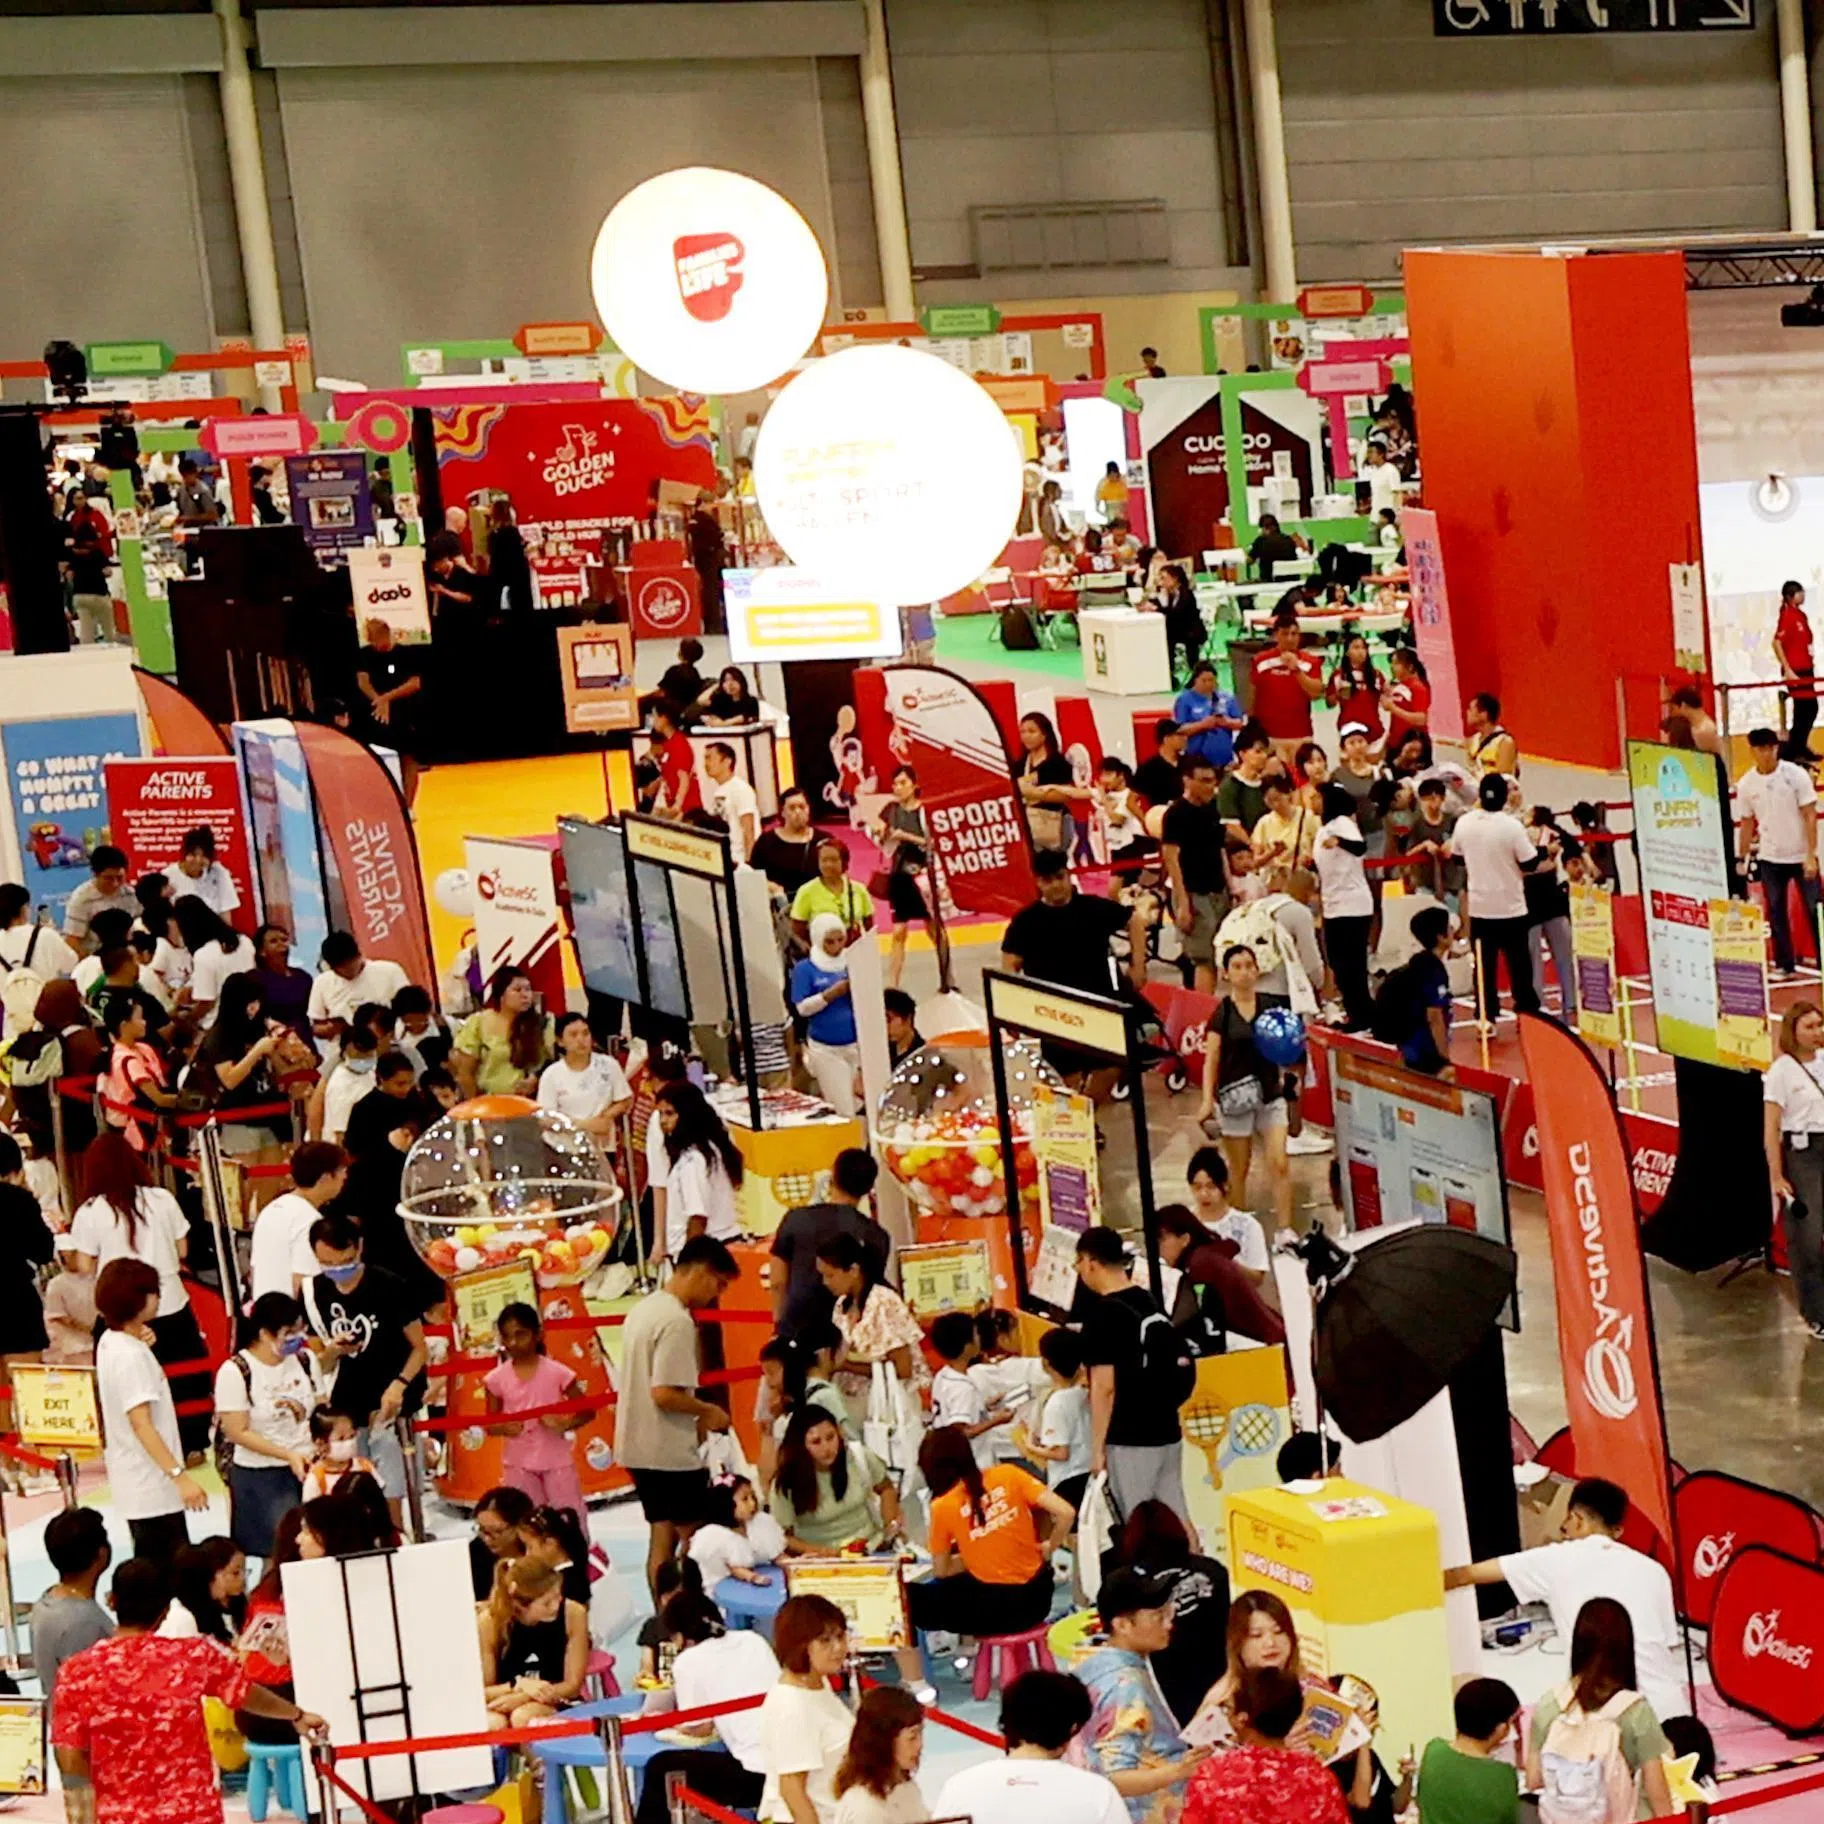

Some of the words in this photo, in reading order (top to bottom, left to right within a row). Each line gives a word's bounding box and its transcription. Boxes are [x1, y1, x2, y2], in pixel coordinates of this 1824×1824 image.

[1184, 433, 1271, 452] CUCOO
[543, 451, 615, 482] GOLDEN
[555, 470, 604, 496] DUCK
[367, 584, 411, 603] doob
[147, 771, 206, 787] ACTIVE
[140, 784, 213, 800] PARENTS
[931, 800, 1011, 834] SPORT
[938, 832, 956, 854] &
[960, 818, 1022, 853] MUCH
[943, 845, 1009, 879] MORE
[44, 1397, 70, 1411] EXIT
[44, 1417, 77, 1430] HERE
[1764, 1632, 1812, 1671] ActiveSG
